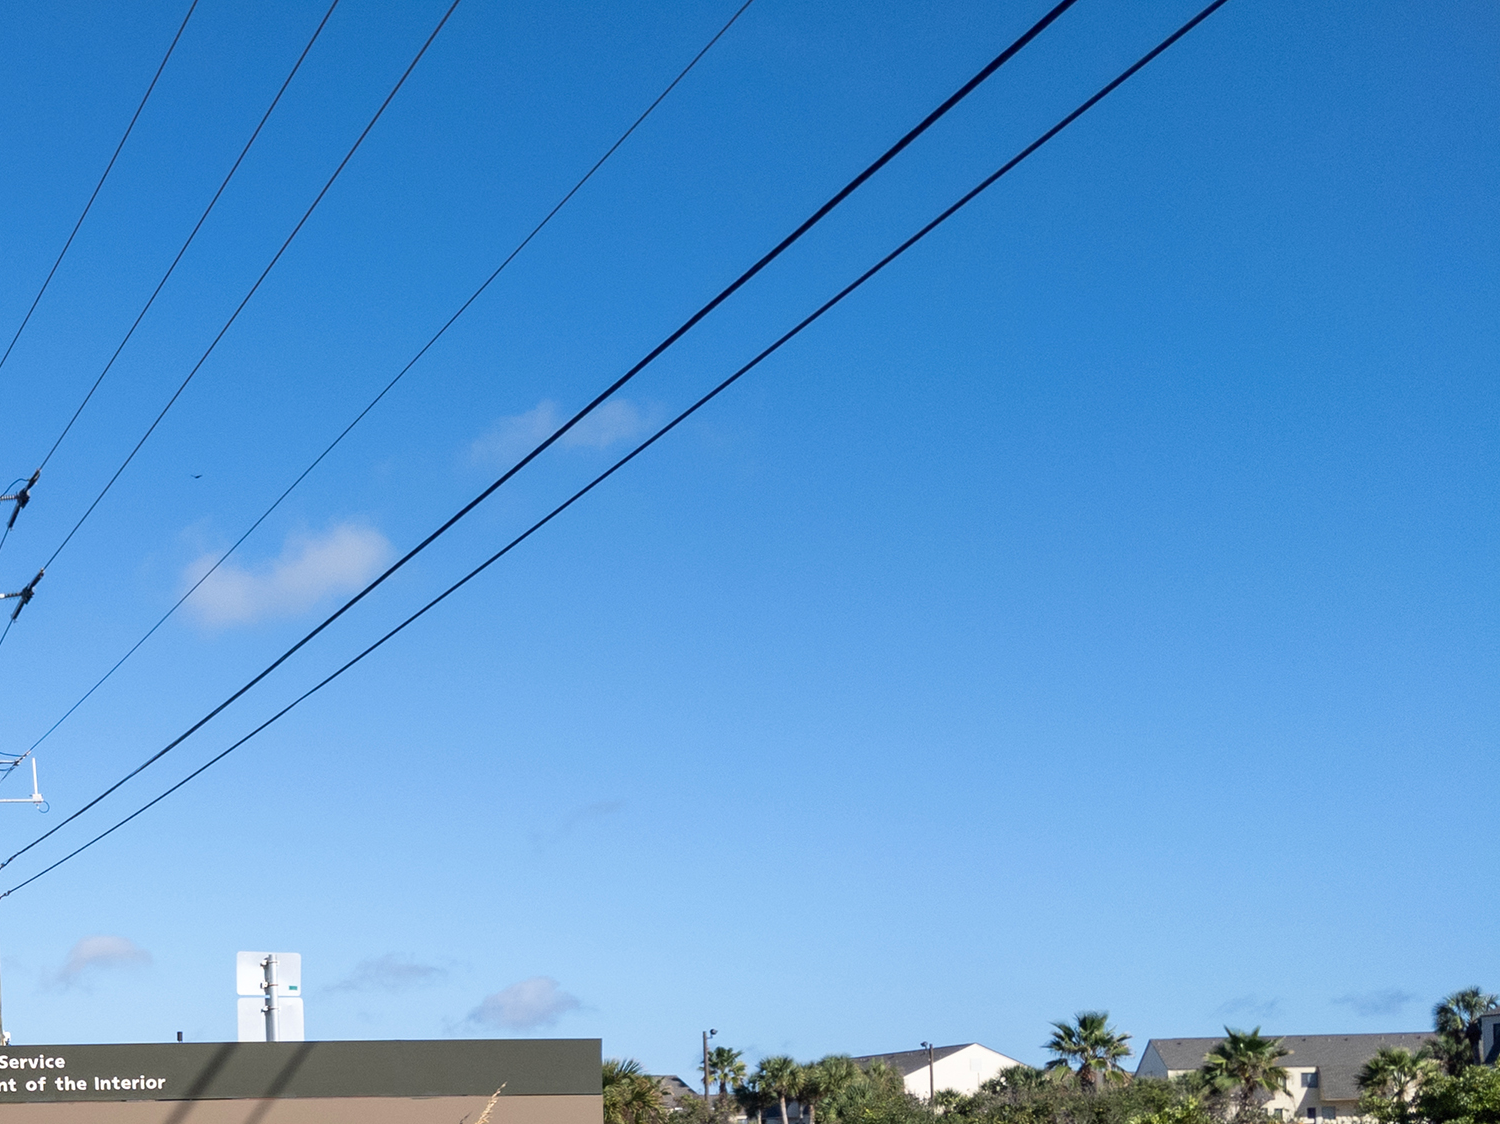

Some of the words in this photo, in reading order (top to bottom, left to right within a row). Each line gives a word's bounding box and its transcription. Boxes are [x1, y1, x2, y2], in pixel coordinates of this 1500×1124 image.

[25, 1077, 47, 1093] of
[54, 1076, 88, 1092] the
[94, 1075, 167, 1091] Interior
